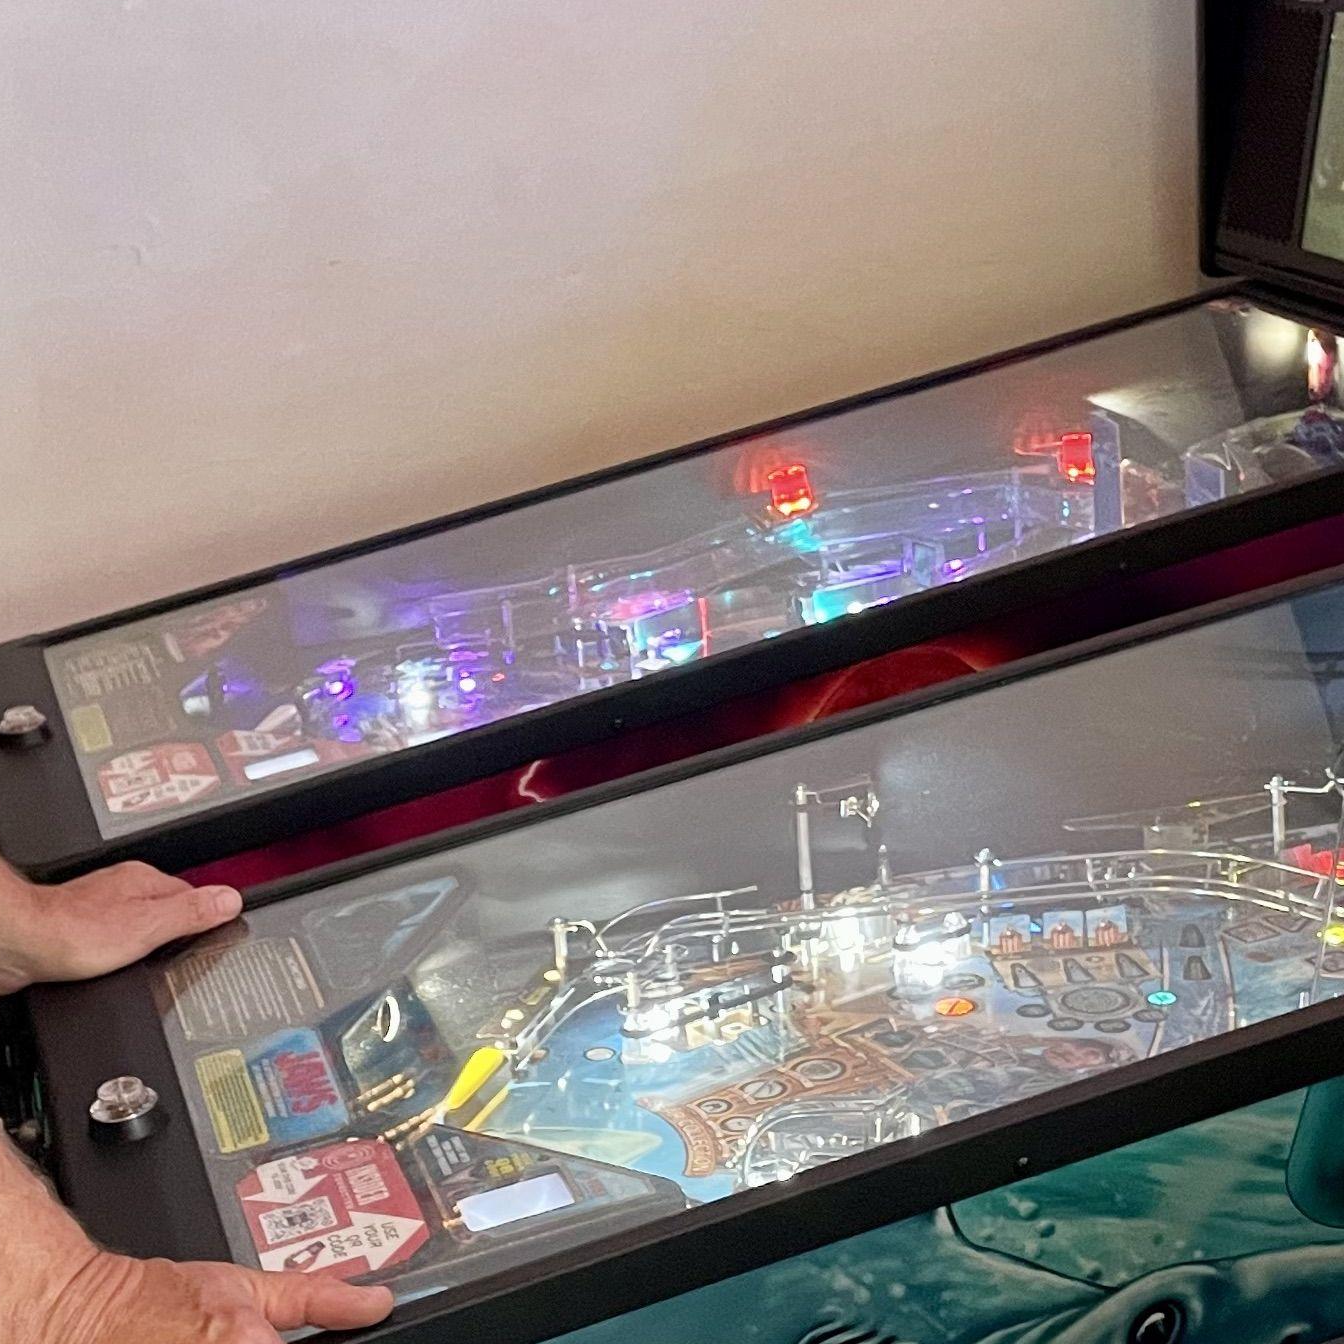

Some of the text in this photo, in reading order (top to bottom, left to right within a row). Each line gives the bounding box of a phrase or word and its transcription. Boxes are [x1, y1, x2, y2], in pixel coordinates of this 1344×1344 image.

[274, 1050, 341, 1119] JAWS
[344, 1163, 390, 1207] INSIDER
[344, 1233, 363, 1247] QR
[363, 1222, 383, 1249] YOUR
[380, 1220, 400, 1241] USE
[327, 1233, 348, 1259] CODE
